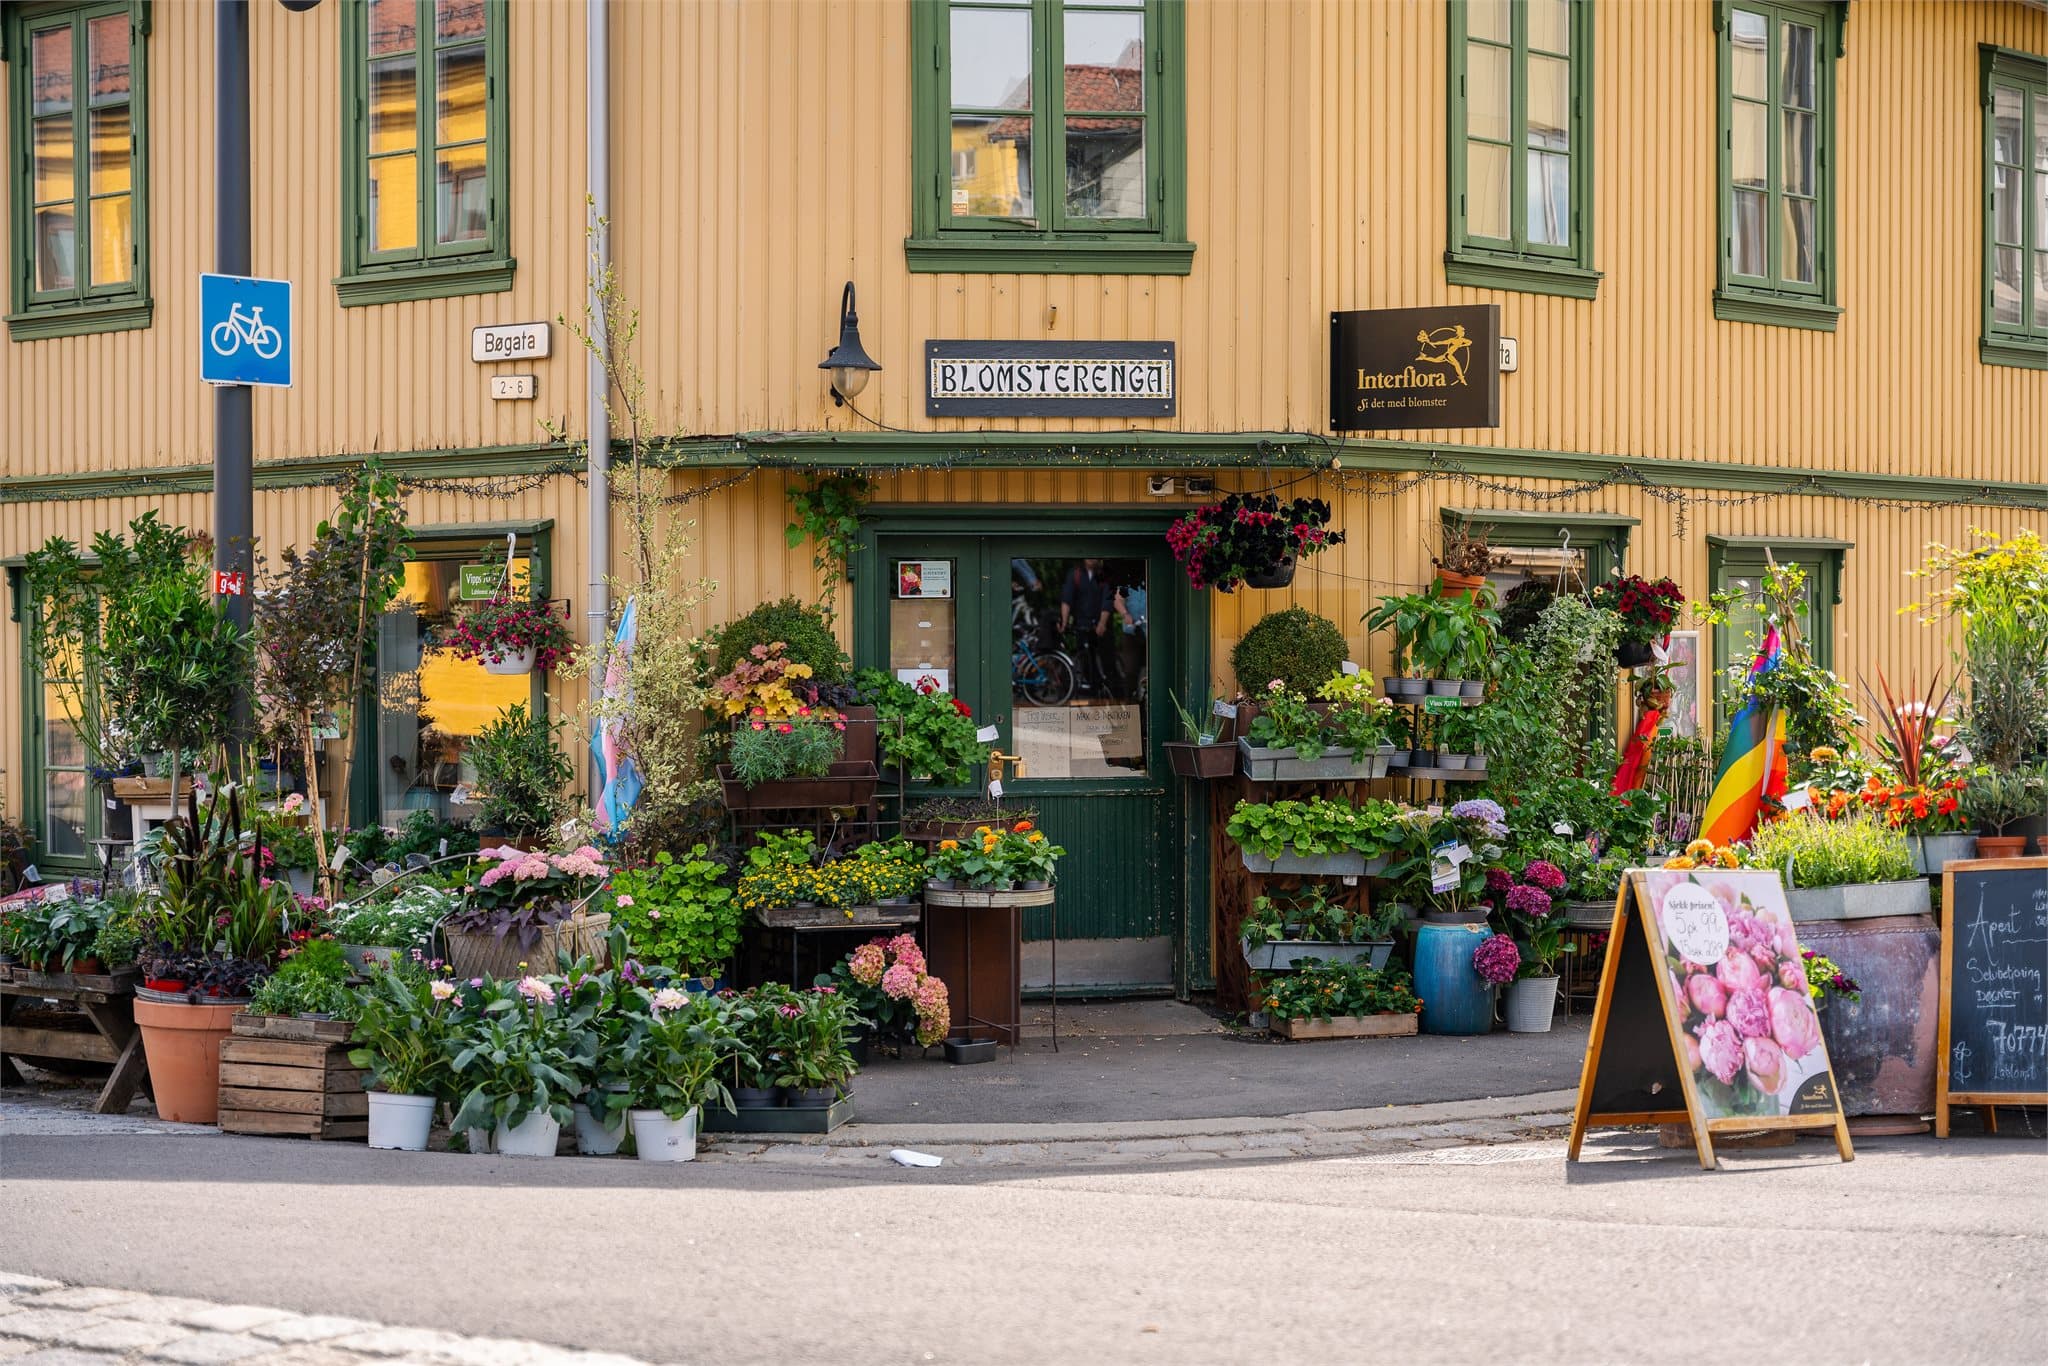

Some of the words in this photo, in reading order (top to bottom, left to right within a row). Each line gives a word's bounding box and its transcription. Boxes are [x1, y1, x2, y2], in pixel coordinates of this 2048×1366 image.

[485, 331, 536, 357] Bøgata
[941, 364, 1163, 393] BLOMSTERENGA
[1357, 365, 1447, 390] Interflora
[1371, 398, 1385, 409] det
[1387, 397, 1406, 408] med
[1408, 397, 1448, 407] blomster
[466, 573, 481, 586] Vipps
